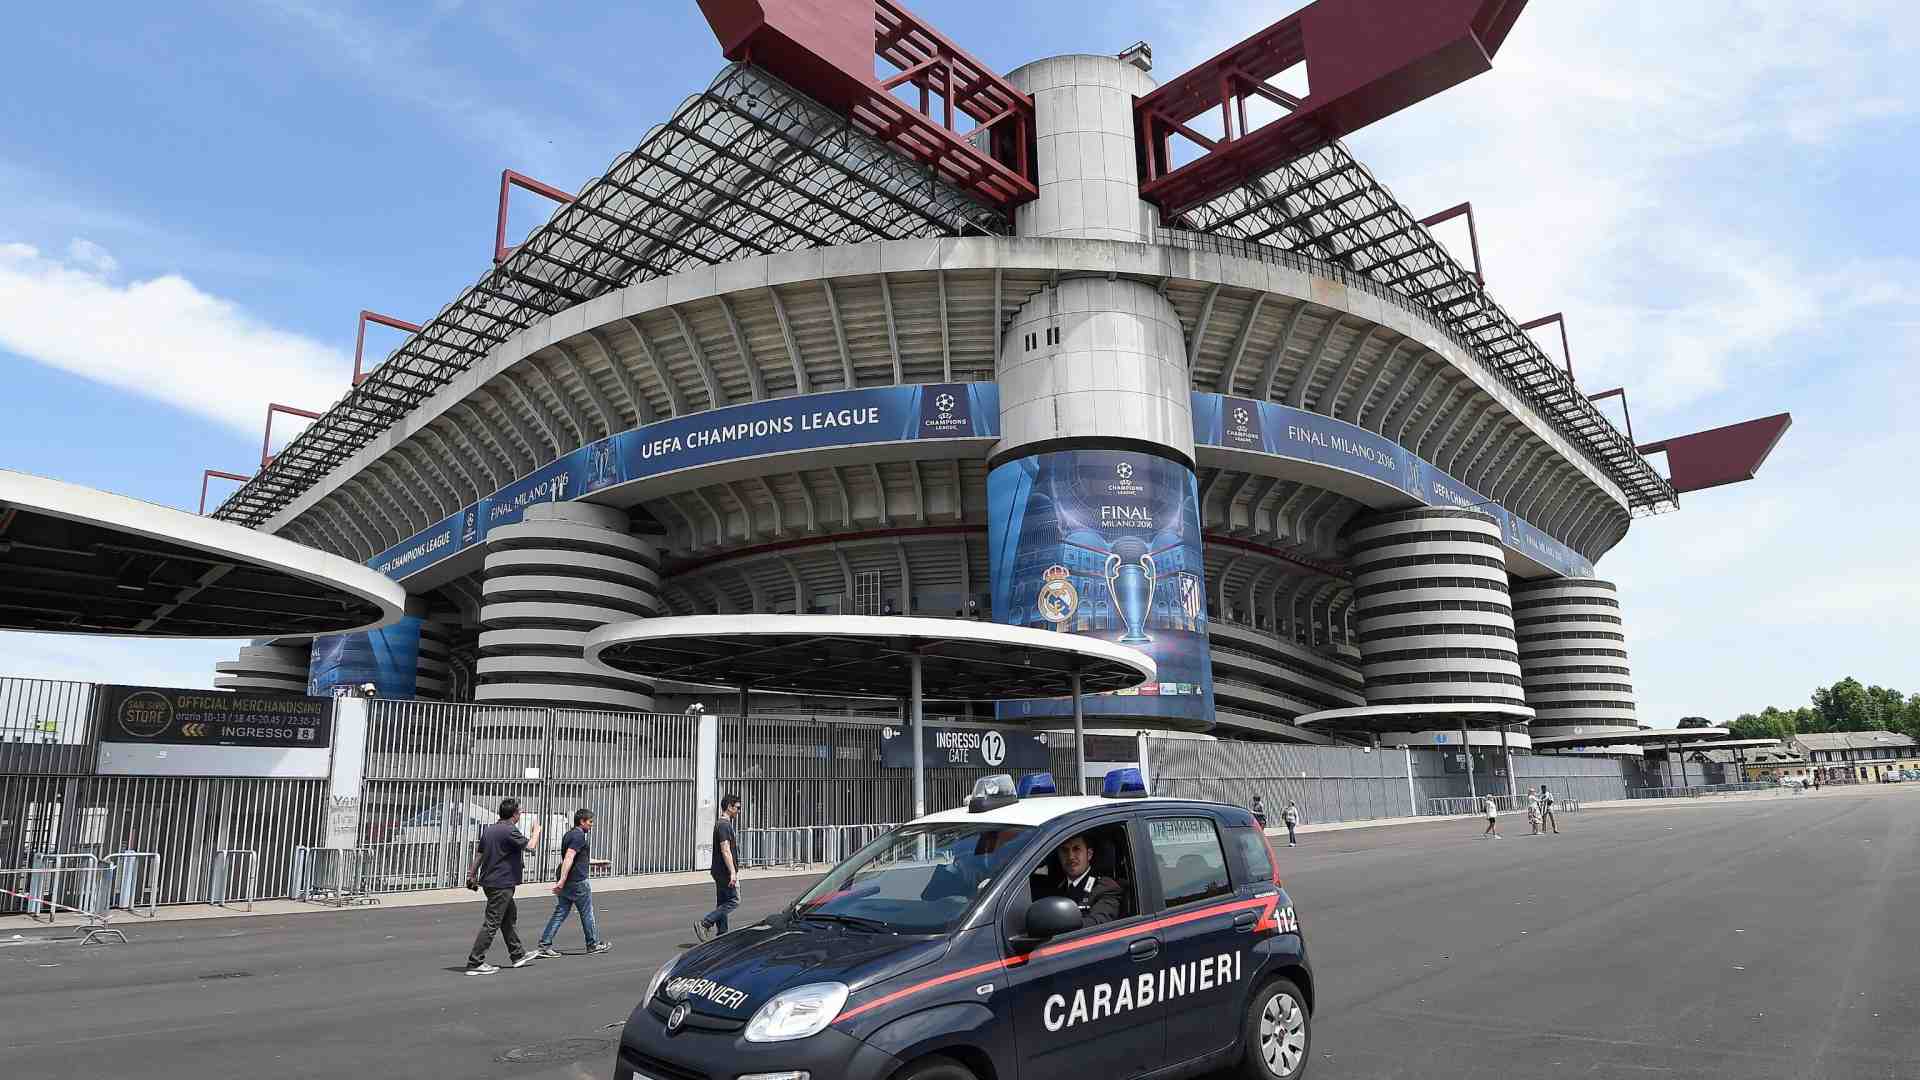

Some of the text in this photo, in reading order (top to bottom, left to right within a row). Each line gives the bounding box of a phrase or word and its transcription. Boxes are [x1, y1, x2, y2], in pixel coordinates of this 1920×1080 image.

[642, 407, 880, 459] UEFA CHAMPIONS LEAGUE
[1287, 425, 1395, 470] FINAL MILANO 2016
[490, 503, 513, 521] FINAL
[514, 482, 548, 508] MILANO
[1101, 505, 1153, 520] FINAL
[1101, 520, 1153, 529] MILANO 2016
[392, 543, 425, 570] CHAMPIONS
[426, 531, 451, 552] LEAGUE
[128, 709, 167, 723] STORE
[176, 695, 322, 715] OFFICIAL MERCHANDISING
[221, 727, 293, 739] INGRESSO
[936, 732, 1002, 761] INGRESSO 12
[948, 749, 969, 763] GATE
[1273, 906, 1298, 934] 112
[665, 976, 749, 1010] CARABINIERI
[1043, 950, 1241, 1032] CARABINIERI
